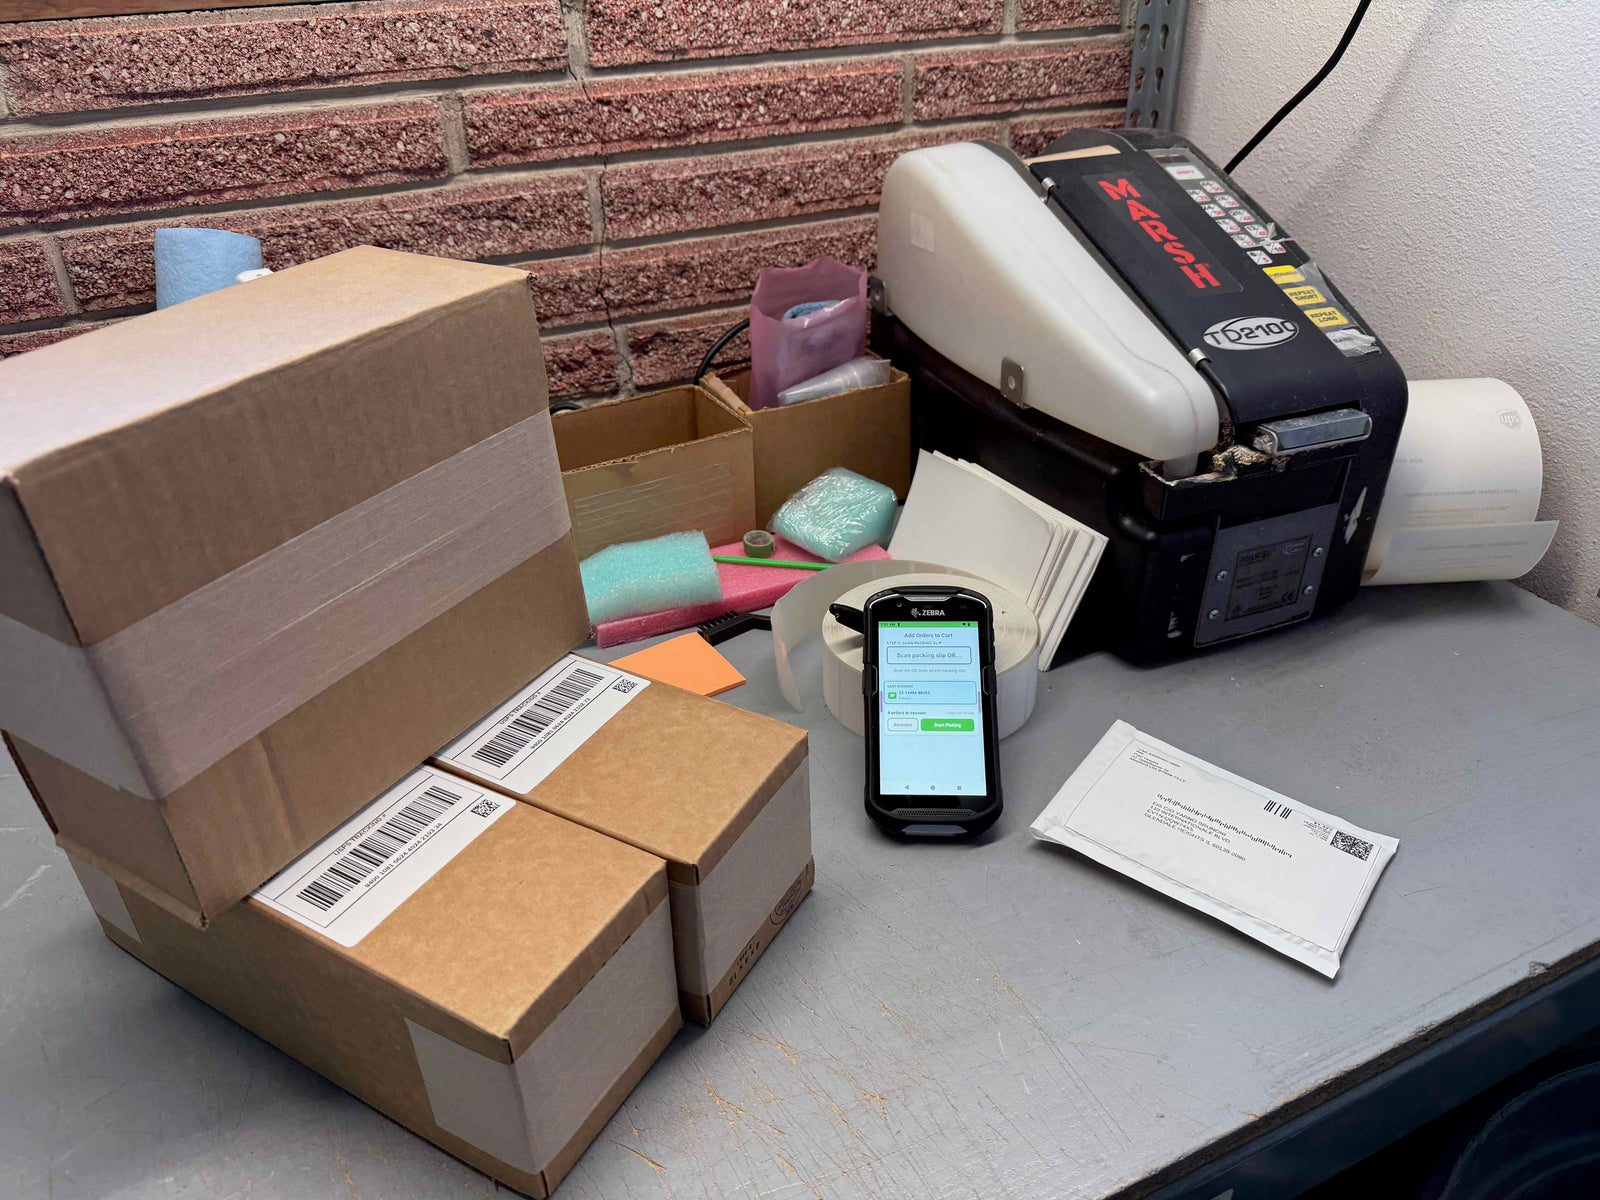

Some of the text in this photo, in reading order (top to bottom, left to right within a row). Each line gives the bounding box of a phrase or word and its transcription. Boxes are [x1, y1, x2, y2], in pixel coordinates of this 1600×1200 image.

[1098, 178, 1221, 289] MARSH
[1289, 289, 1316, 297] REPEAT
[1310, 310, 1337, 318] REPEAT
[1204, 320, 1298, 346] TD2100
[1500, 413, 1520, 427] ups
[499, 713, 514, 725] USPS
[511, 694, 537, 714] TRACKING
[333, 842, 352, 856] USPS
[351, 818, 382, 842] TRACKING
[1144, 812, 1176, 830] GLENDALE
[1177, 827, 1205, 842] HEIGHTS
[1161, 809, 1213, 835] INTERNATIONALE
[1213, 833, 1231, 844] BLVD
[379, 863, 395, 876] 1081
